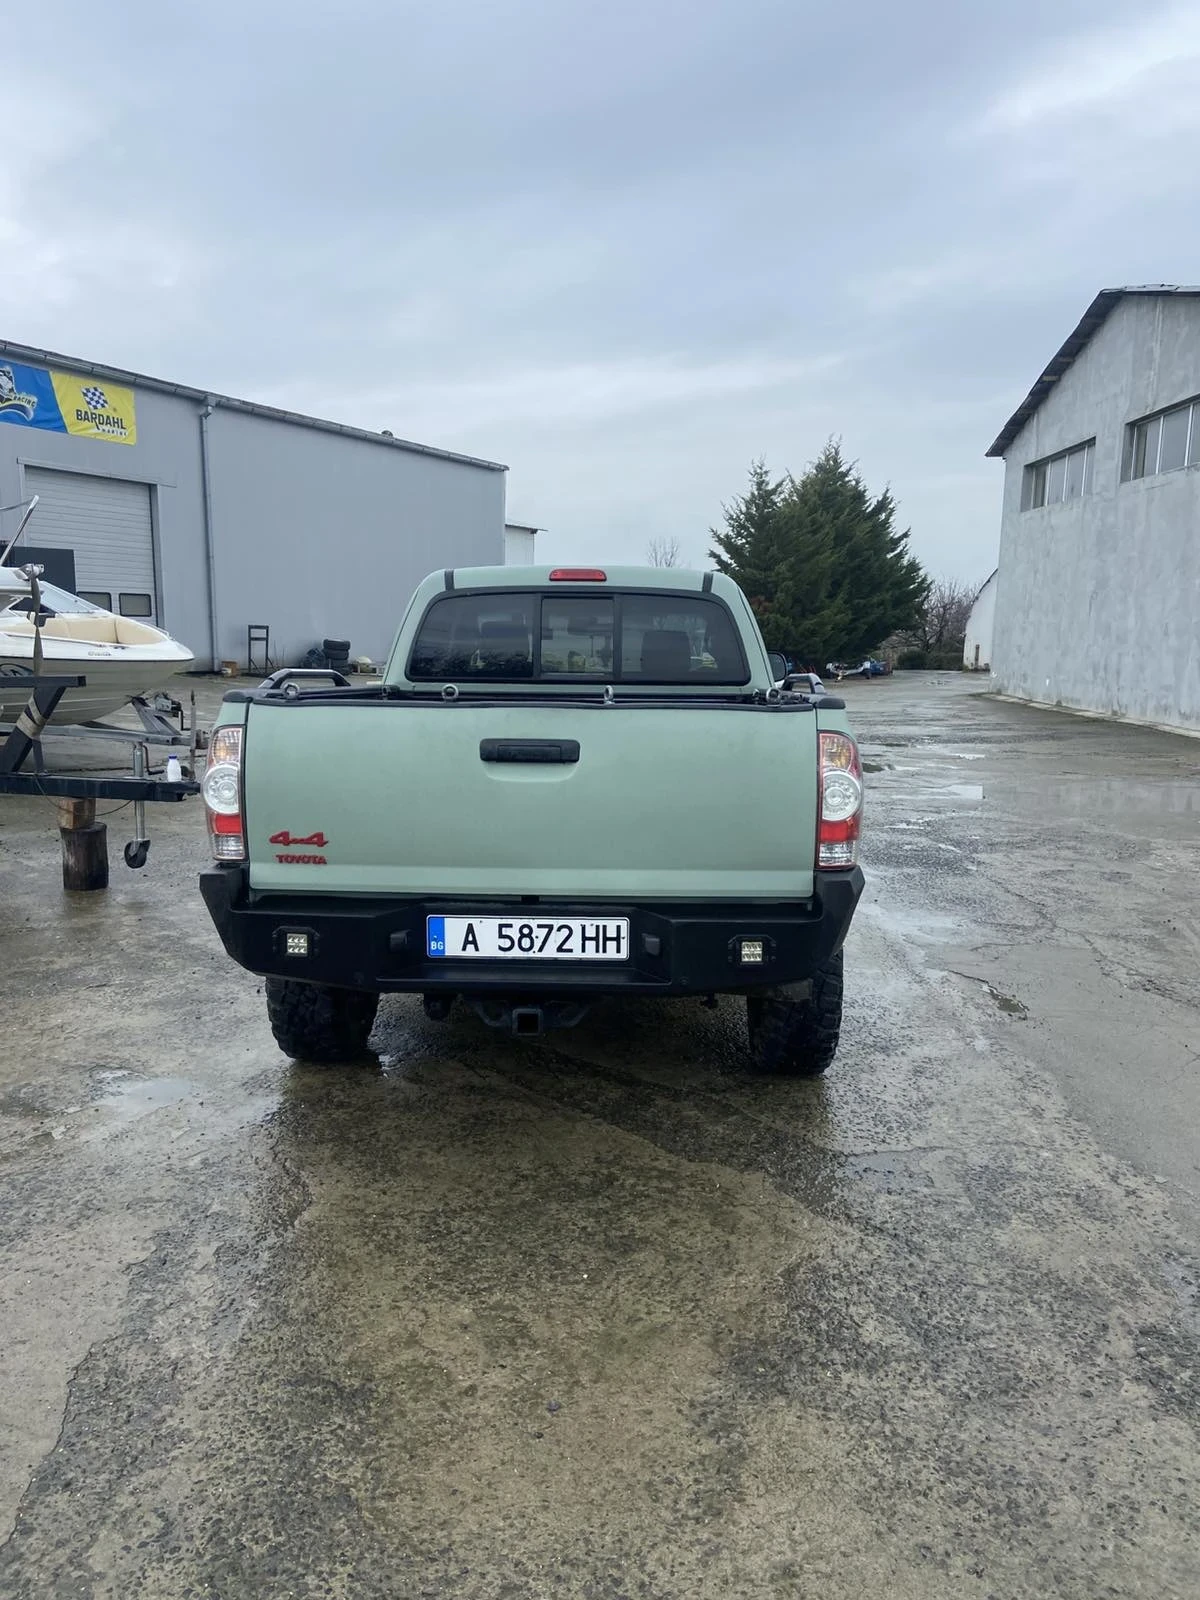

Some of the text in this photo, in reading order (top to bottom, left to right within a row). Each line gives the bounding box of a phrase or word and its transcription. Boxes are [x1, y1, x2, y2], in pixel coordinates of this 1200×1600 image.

[13, 395, 36, 407] RACING
[76, 409, 126, 430] BARDAHL
[276, 854, 327, 865] TOYOTA
[461, 923, 621, 954] A 5872 HH
[431, 941, 444, 950] BG
